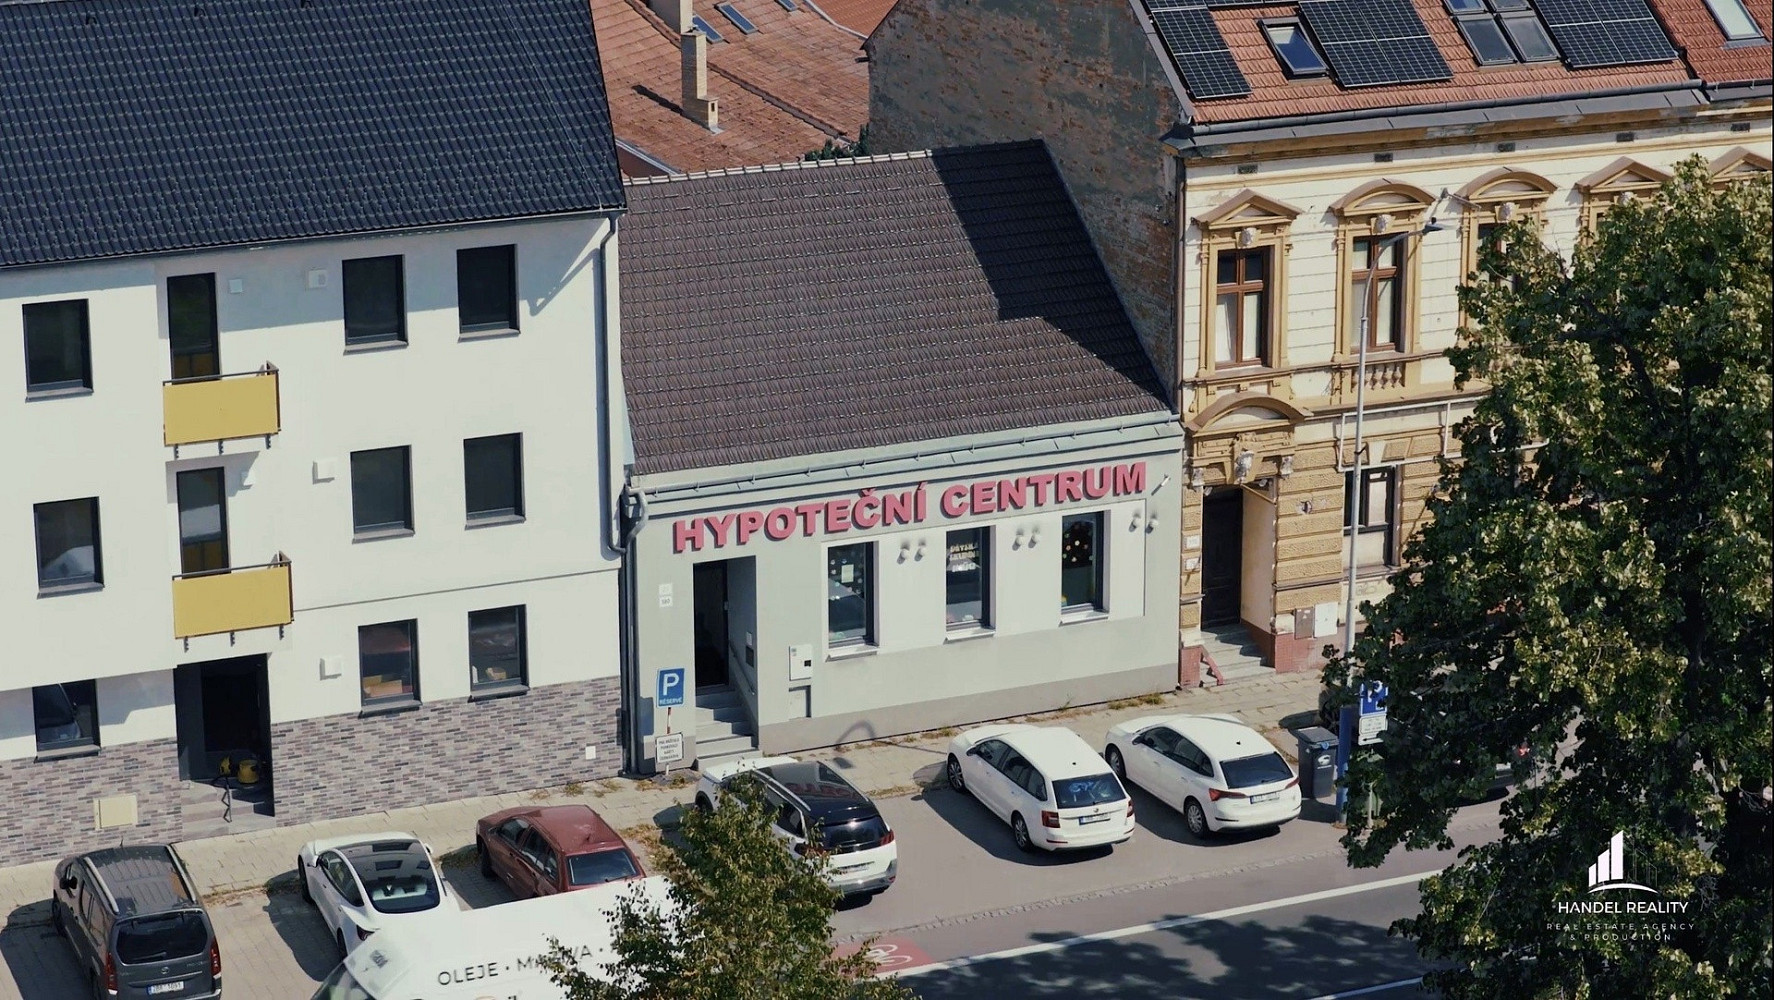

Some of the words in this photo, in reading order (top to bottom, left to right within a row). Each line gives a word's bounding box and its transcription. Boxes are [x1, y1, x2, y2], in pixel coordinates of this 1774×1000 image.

[673, 482, 928, 553] HYPOTEČNÍ
[940, 462, 1146, 518] CENTRUM
[663, 673, 680, 696] P
[437, 962, 499, 986] OLEJE
